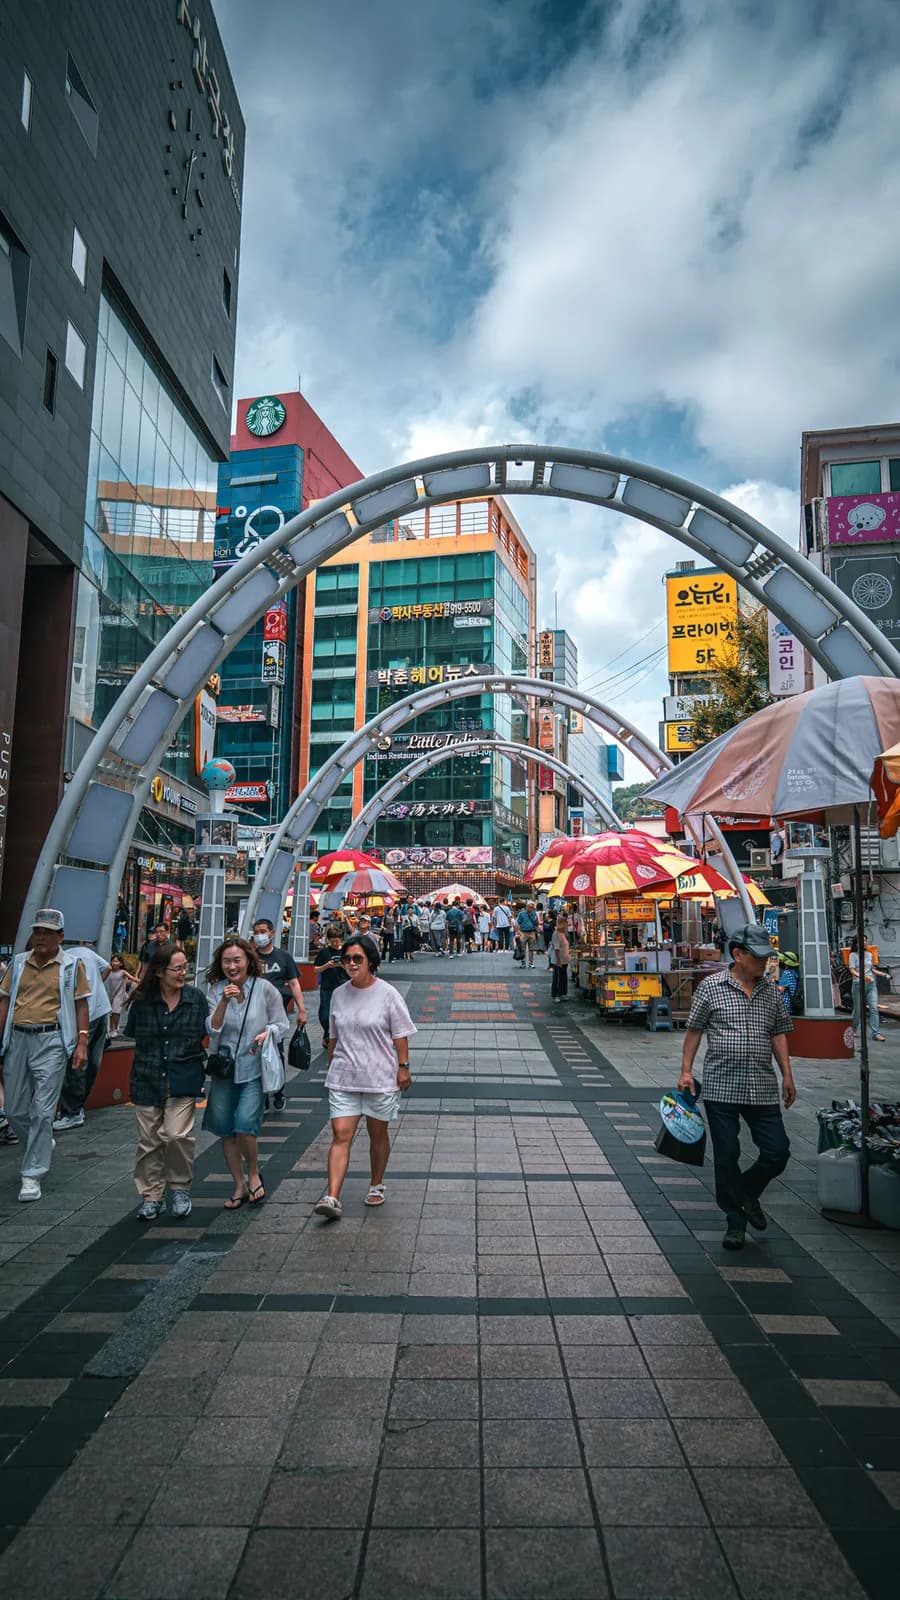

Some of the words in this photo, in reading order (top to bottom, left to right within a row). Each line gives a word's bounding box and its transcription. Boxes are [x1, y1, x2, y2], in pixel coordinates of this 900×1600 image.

[779, 639, 795, 671] 코인
[406, 734, 443, 750] Little
[408, 802, 473, 817] 汤火功夫
[261, 962, 281, 973] ILA
